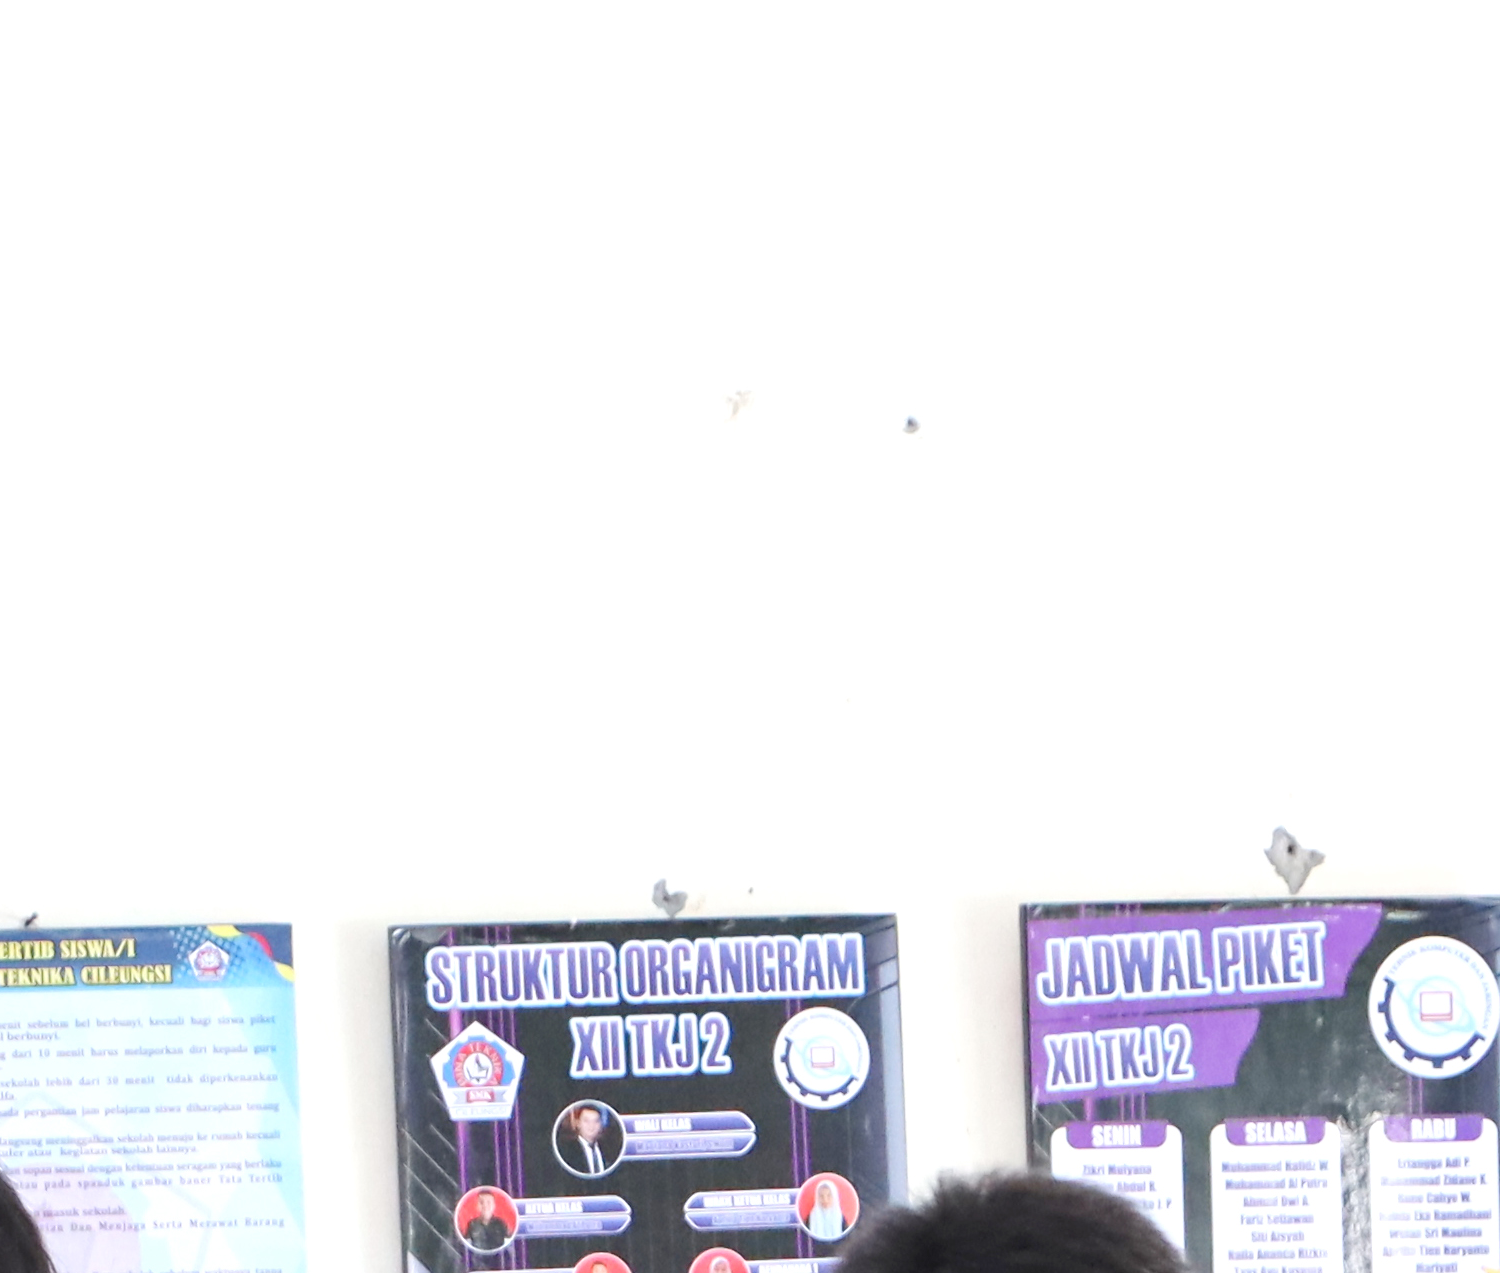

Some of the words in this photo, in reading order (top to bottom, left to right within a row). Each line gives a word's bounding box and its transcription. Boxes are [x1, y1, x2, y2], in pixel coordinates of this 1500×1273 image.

[60, 938, 136, 959] SISWA/I
[81, 964, 173, 984] CILEUNGSI
[427, 945, 617, 1007] STRUKTUR
[623, 935, 863, 999] ORGANIGRAM
[1039, 932, 1211, 1001] JADWAL
[1214, 924, 1324, 990] PIKET
[572, 1018, 625, 1074] XII
[627, 1015, 698, 1071] TKJ
[699, 1014, 730, 1069] 2
[1046, 1033, 1095, 1089] XII
[1097, 1028, 1163, 1084] TKJ
[1165, 1026, 1194, 1078] 2
[1091, 1124, 1142, 1147] SENIN
[1244, 1121, 1307, 1144] SELASA
[1410, 1118, 1457, 1140] RABU
